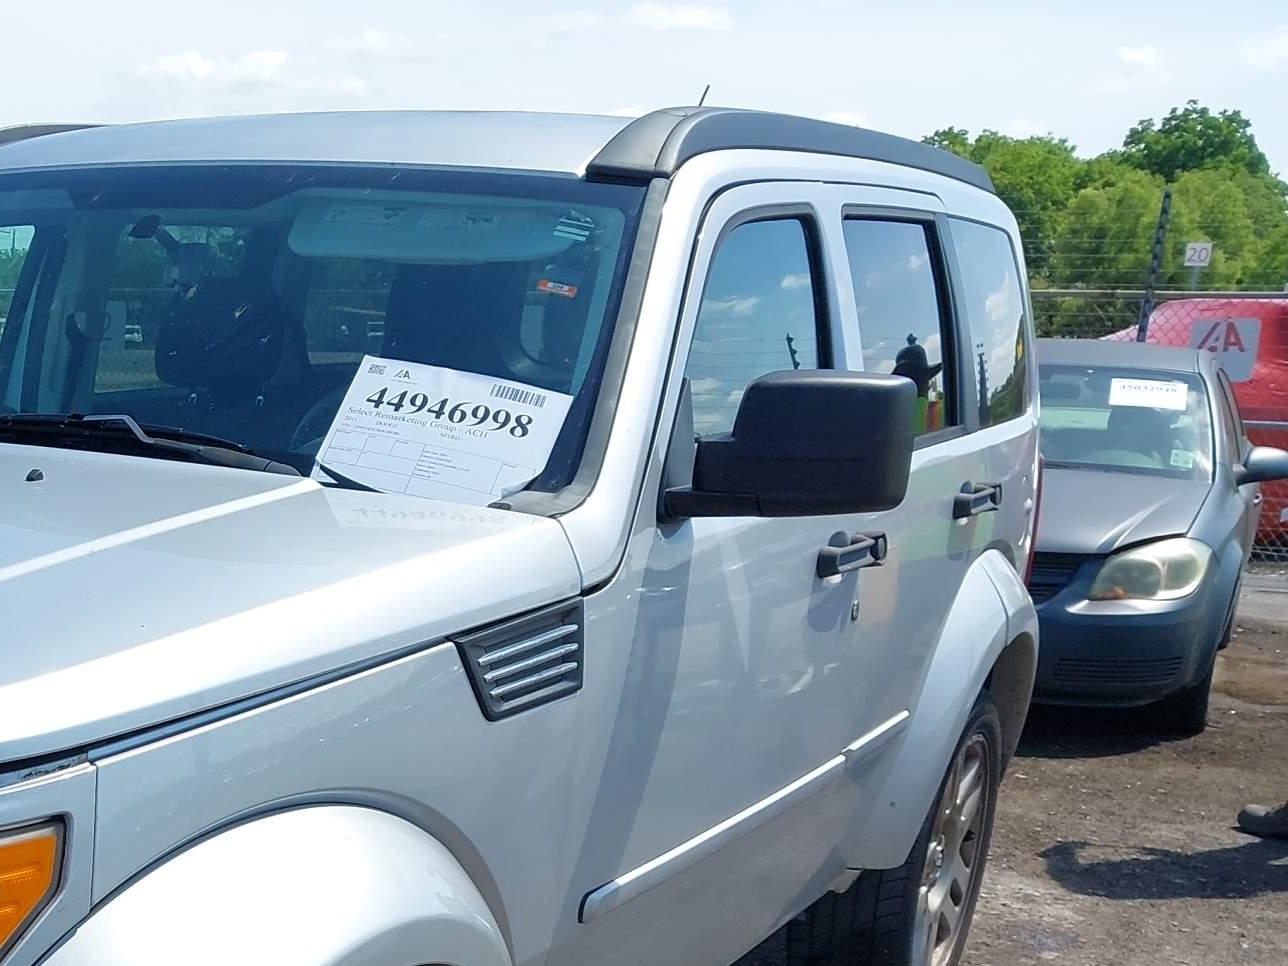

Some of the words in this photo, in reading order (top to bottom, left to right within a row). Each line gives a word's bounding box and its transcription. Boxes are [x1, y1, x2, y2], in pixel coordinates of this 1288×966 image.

[1187, 248, 1209, 262] 20
[347, 406, 375, 418] Select
[373, 409, 429, 430] Remarketing
[429, 418, 457, 434] Group
[464, 427, 490, 441] ACH
[366, 387, 533, 438] 44946998
